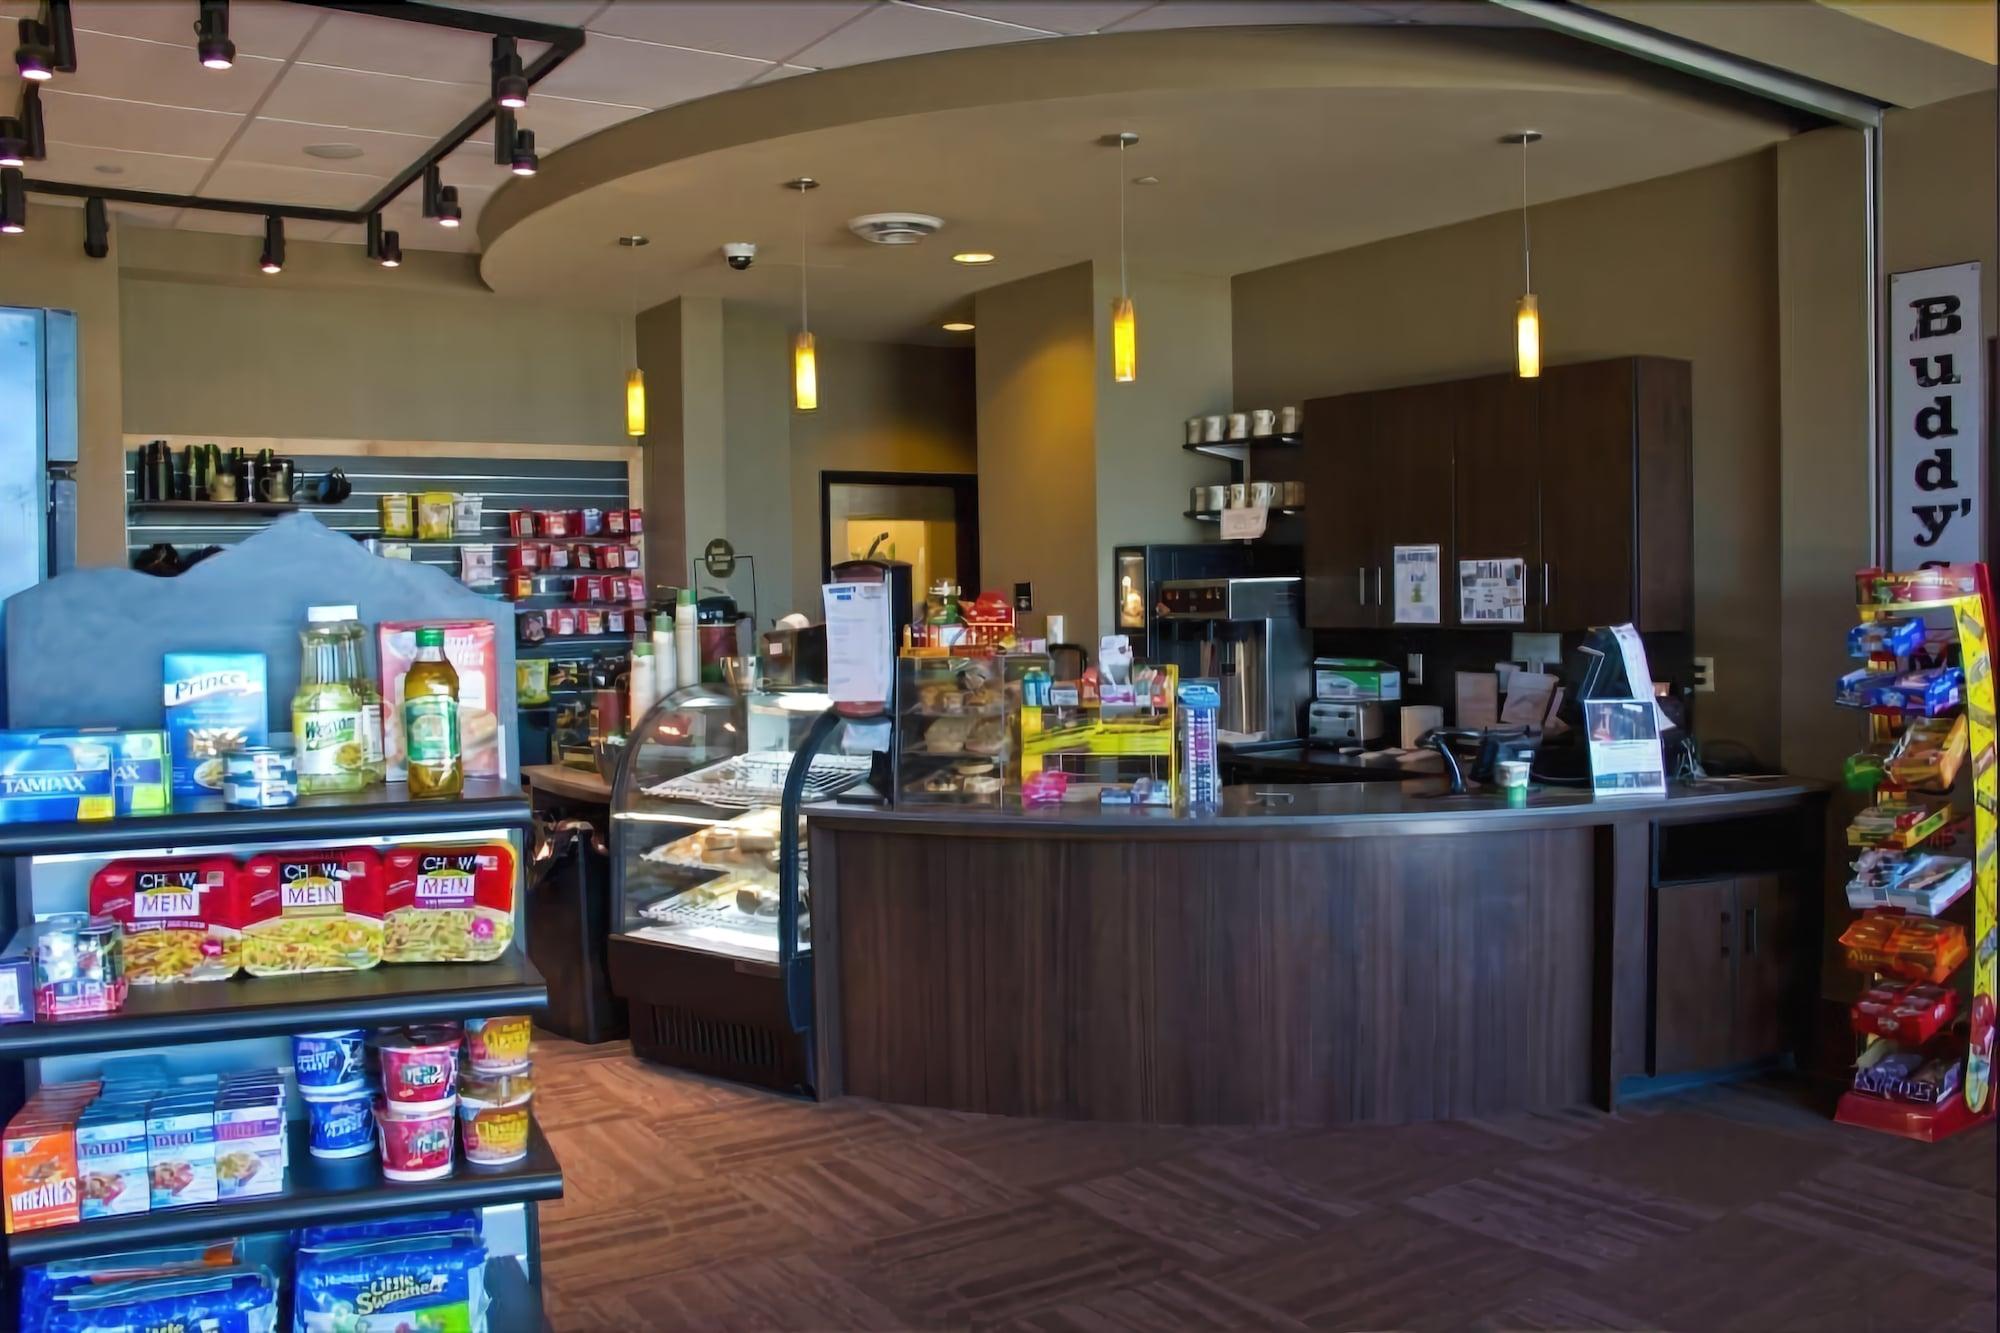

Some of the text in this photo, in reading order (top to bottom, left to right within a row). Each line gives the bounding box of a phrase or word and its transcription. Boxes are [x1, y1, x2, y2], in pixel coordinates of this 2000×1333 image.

[1909, 295, 1972, 571] Buddy'
[2, 775, 86, 794] TAMPAX
[283, 862, 338, 880] CHW
[420, 855, 475, 871] CHW
[139, 871, 197, 888] CHW
[422, 876, 469, 895] MEIN
[141, 893, 193, 913] MEIN
[288, 884, 337, 904] MEIN
